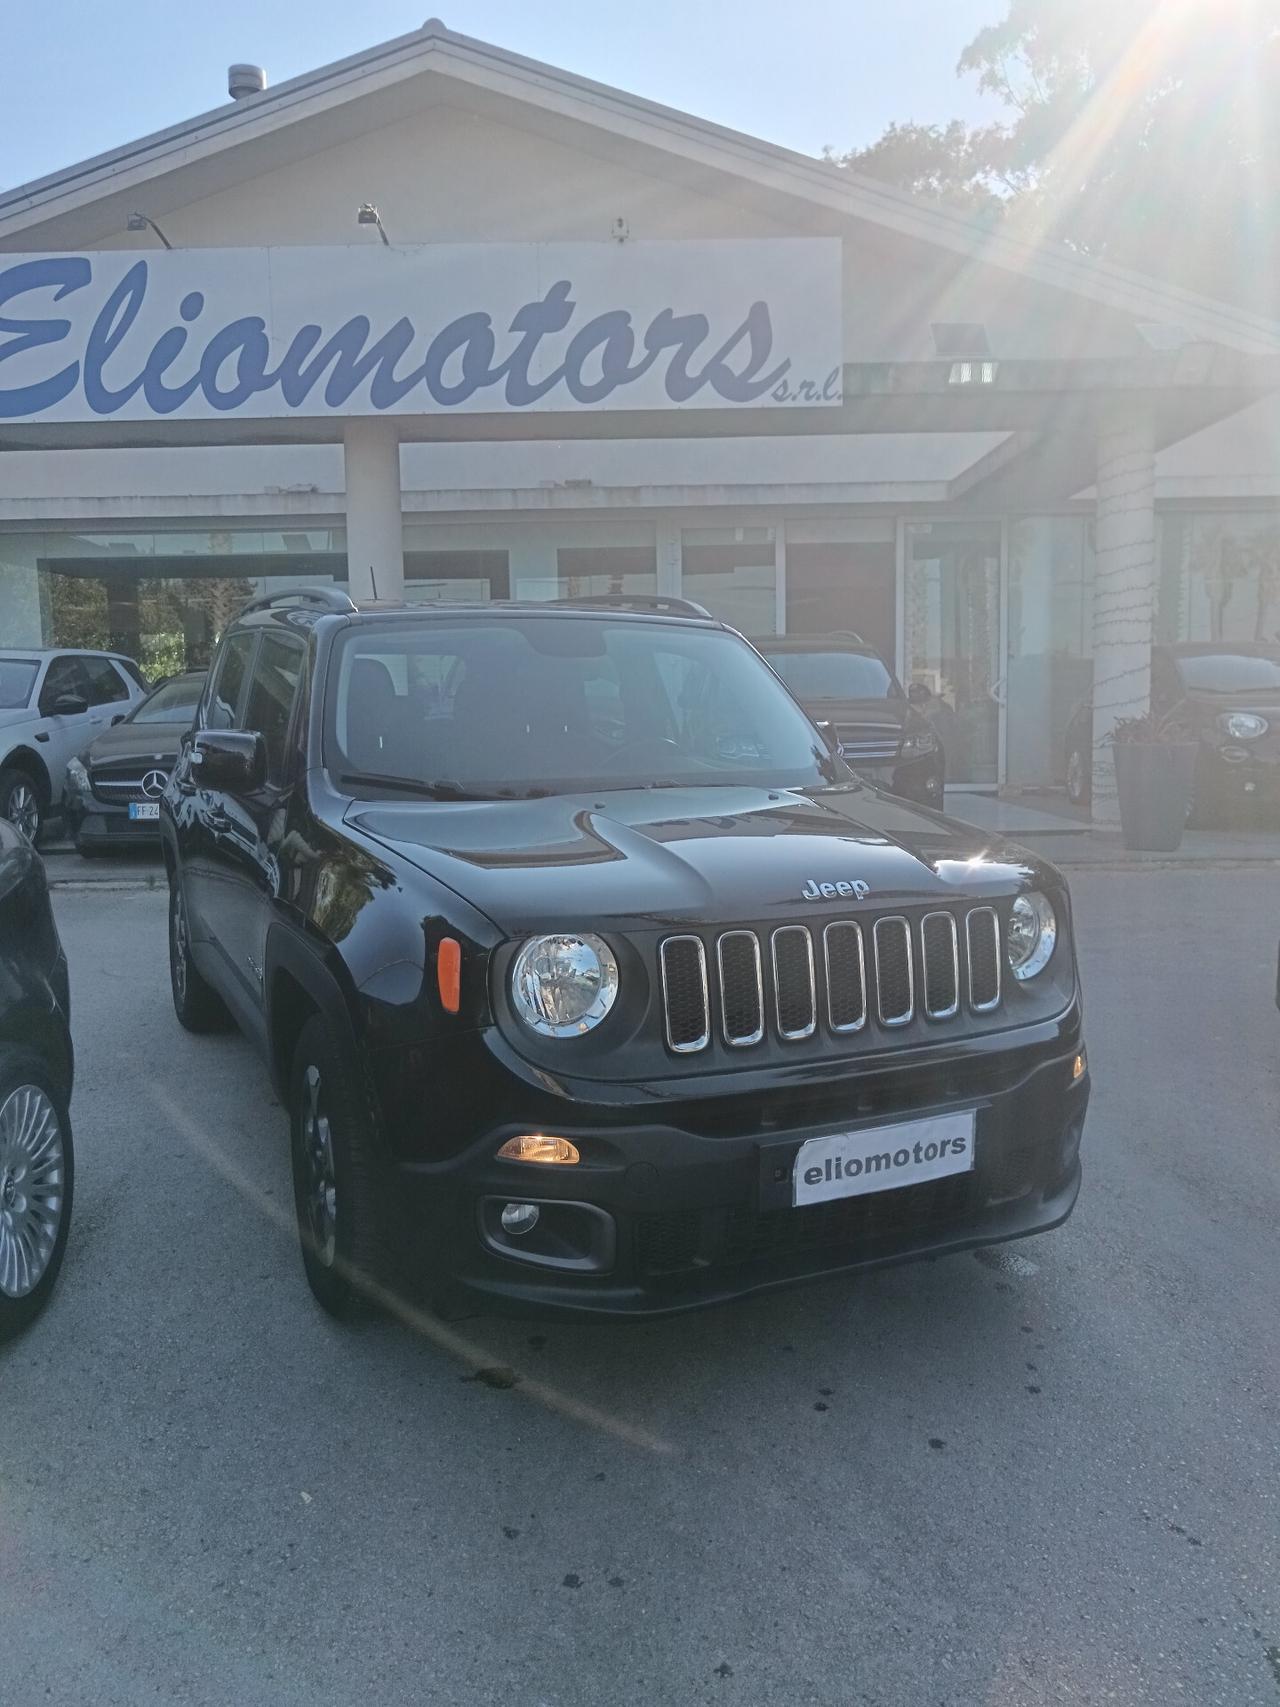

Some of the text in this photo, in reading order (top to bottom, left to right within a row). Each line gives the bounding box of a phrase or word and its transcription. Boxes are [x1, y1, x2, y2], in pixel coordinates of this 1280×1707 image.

[0, 257, 842, 418] Eliomotors s.r.l.
[802, 879, 870, 900] Jeep
[803, 1136, 966, 1186] eliomotors
